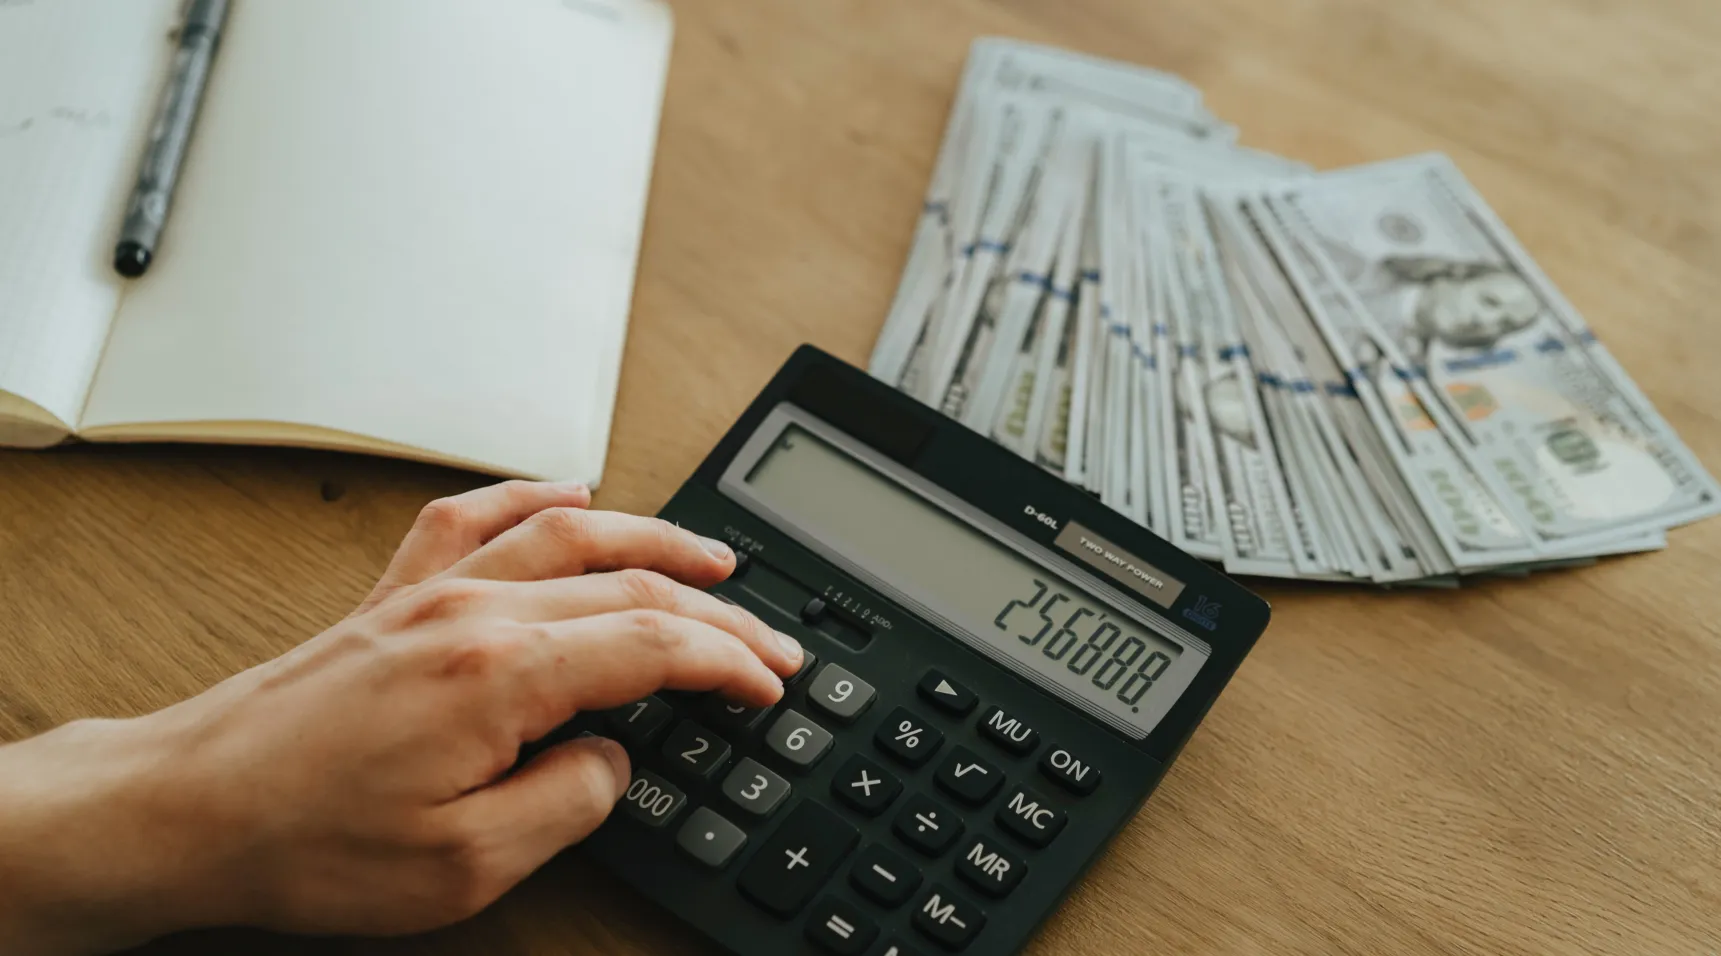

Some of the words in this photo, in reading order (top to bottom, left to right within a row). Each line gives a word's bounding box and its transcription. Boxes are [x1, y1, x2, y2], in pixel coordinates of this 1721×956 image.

[1024, 505, 1057, 530] D-60L
[1080, 536, 1103, 554] TWO
[1104, 551, 1127, 567] WAY
[1126, 564, 1164, 589] POWER
[828, 680, 854, 703] 9
[628, 702, 648, 723] 1
[989, 710, 1032, 742] MU
[681, 737, 709, 764] 2
[786, 727, 813, 751] 6
[1050, 750, 1090, 782] ON
[626, 778, 674, 817] 000
[740, 774, 768, 801] 3
[1008, 792, 1054, 829] MC
[967, 842, 1010, 881] MR
[923, 894, 966, 929] M-
